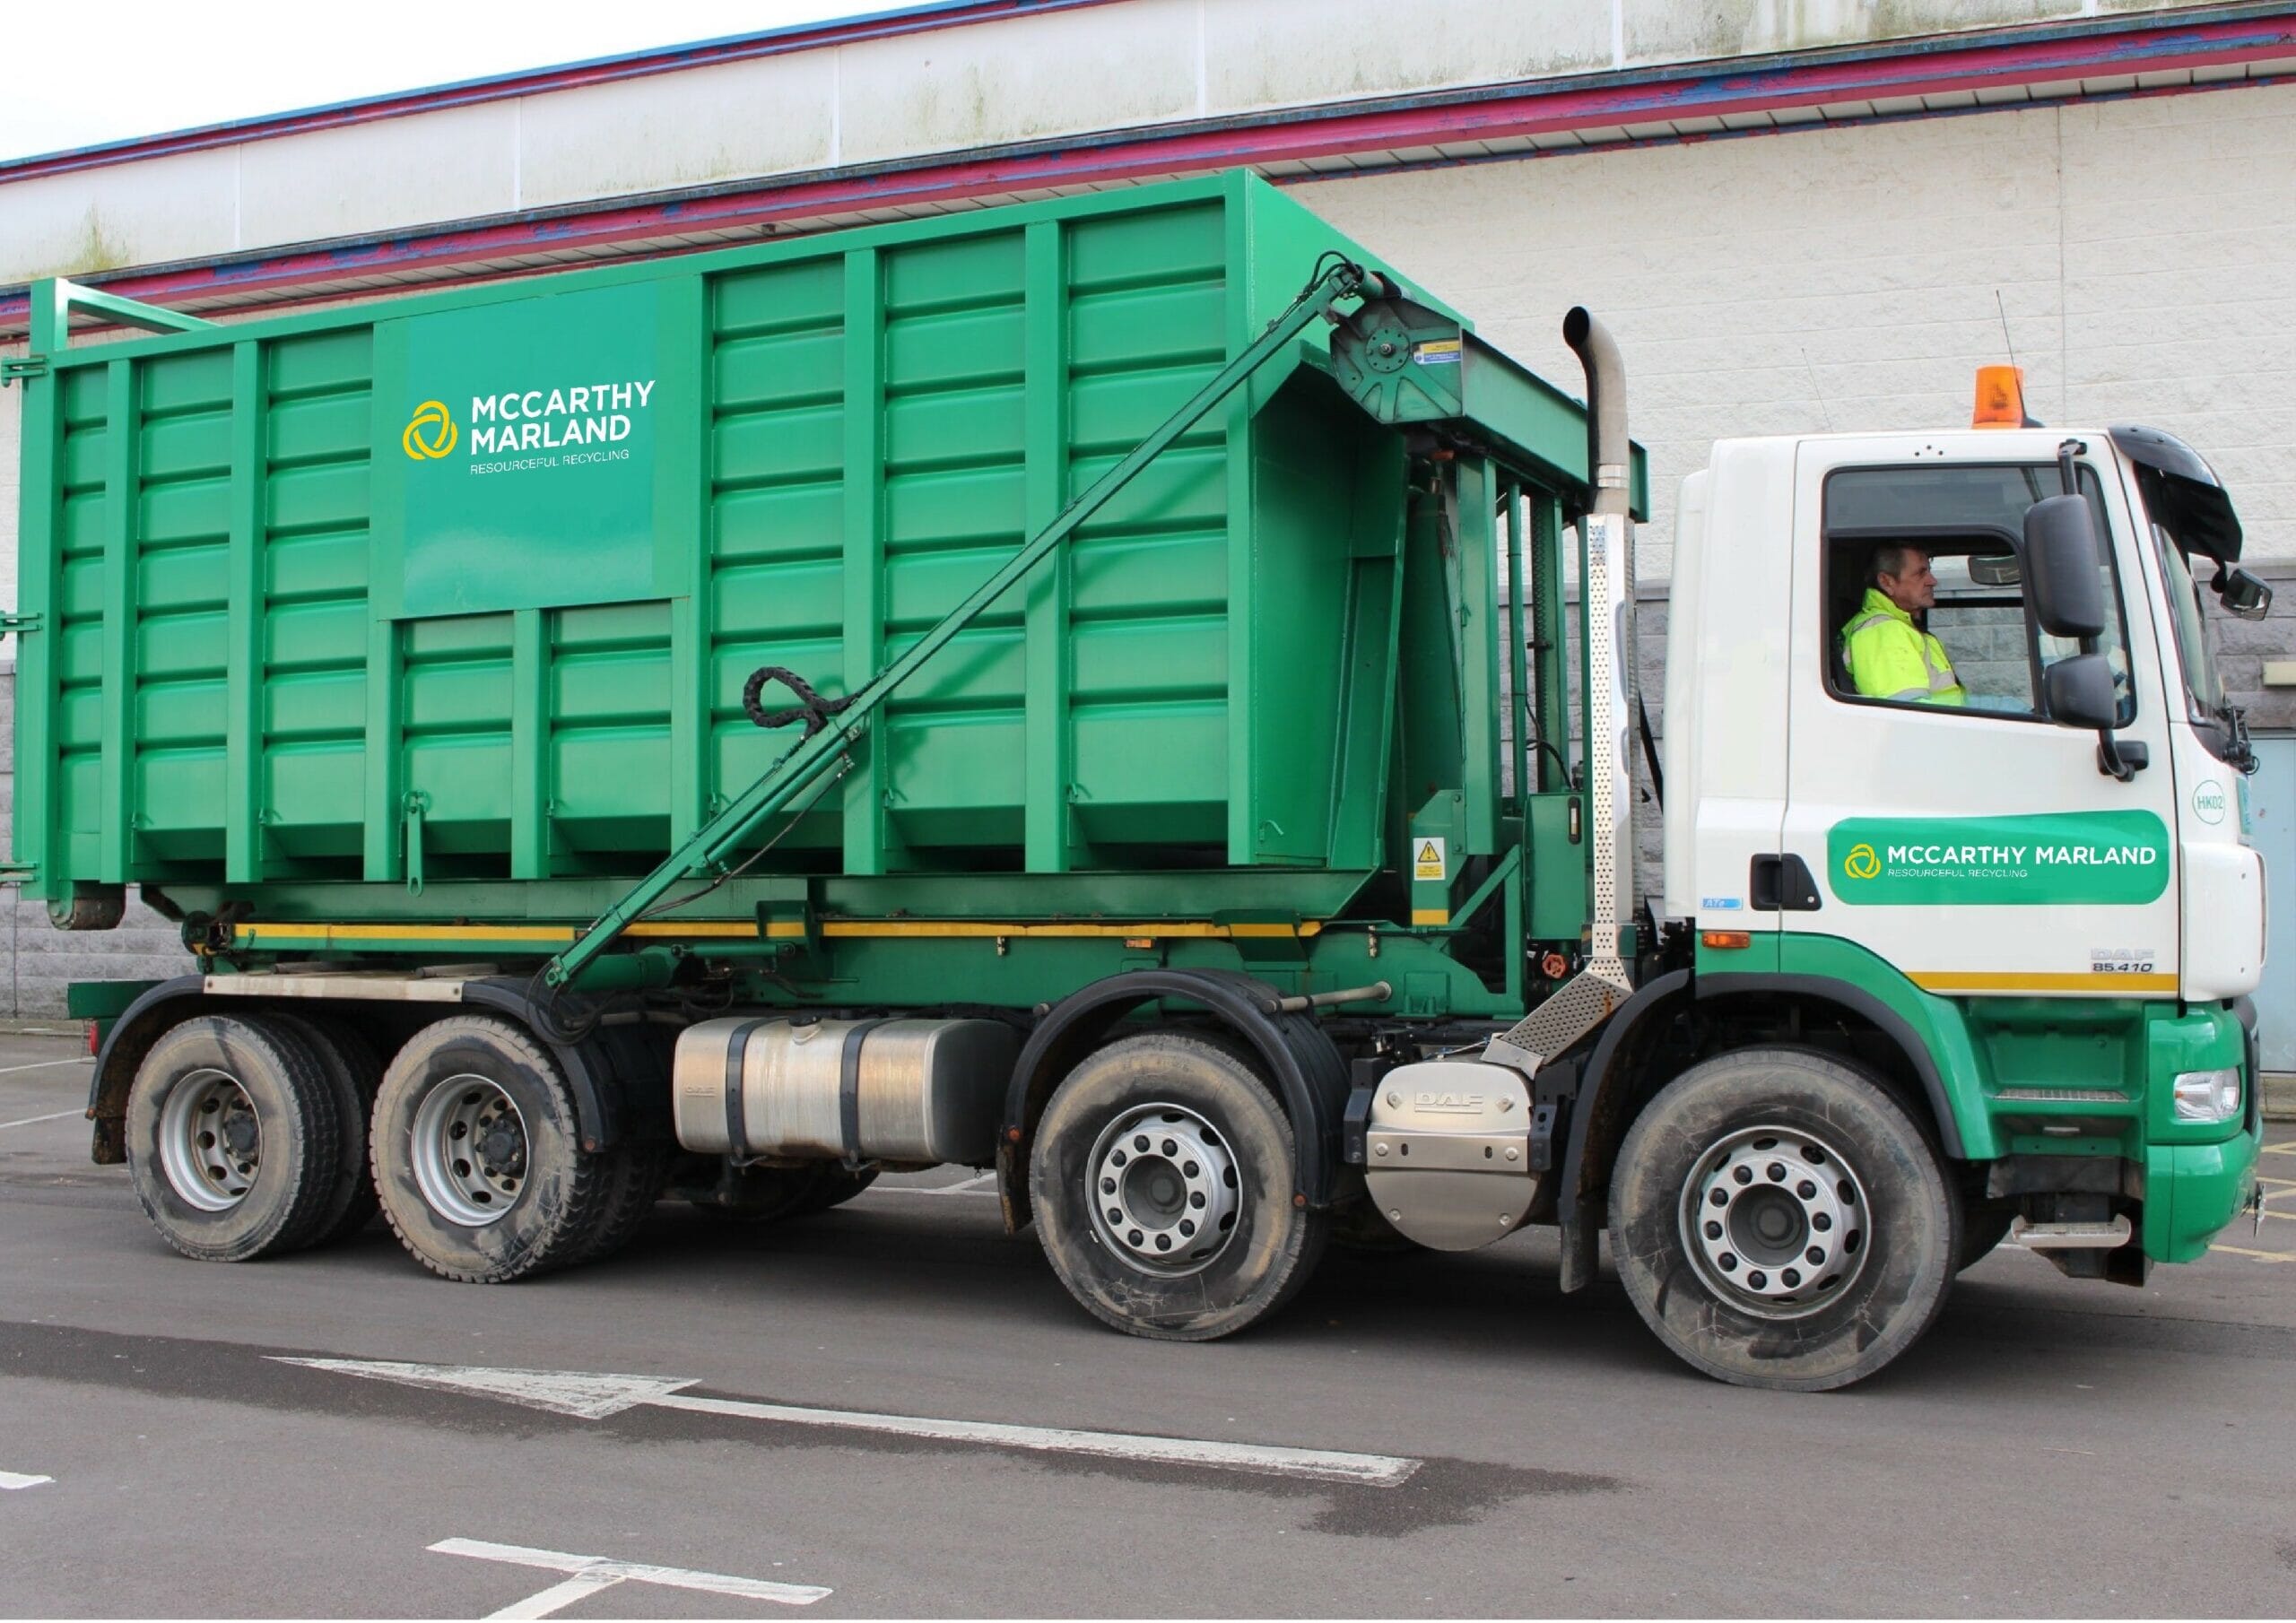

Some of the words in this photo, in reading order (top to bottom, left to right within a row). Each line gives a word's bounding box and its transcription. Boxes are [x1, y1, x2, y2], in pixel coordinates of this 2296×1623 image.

[472, 380, 656, 423] MCCARTHY
[471, 414, 631, 455] MARLAND
[470, 456, 559, 474] RESOURCEFUL
[563, 449, 630, 465] RECYCLING
[1888, 846, 2027, 865] MCCARTHY
[2035, 846, 2157, 865] MARLAND
[1887, 868, 1965, 877] RESOURCEFUL
[1968, 869, 2028, 878] RECYCLING
[2091, 948, 2155, 960] DAF
[1413, 1091, 1483, 1107] DAF
